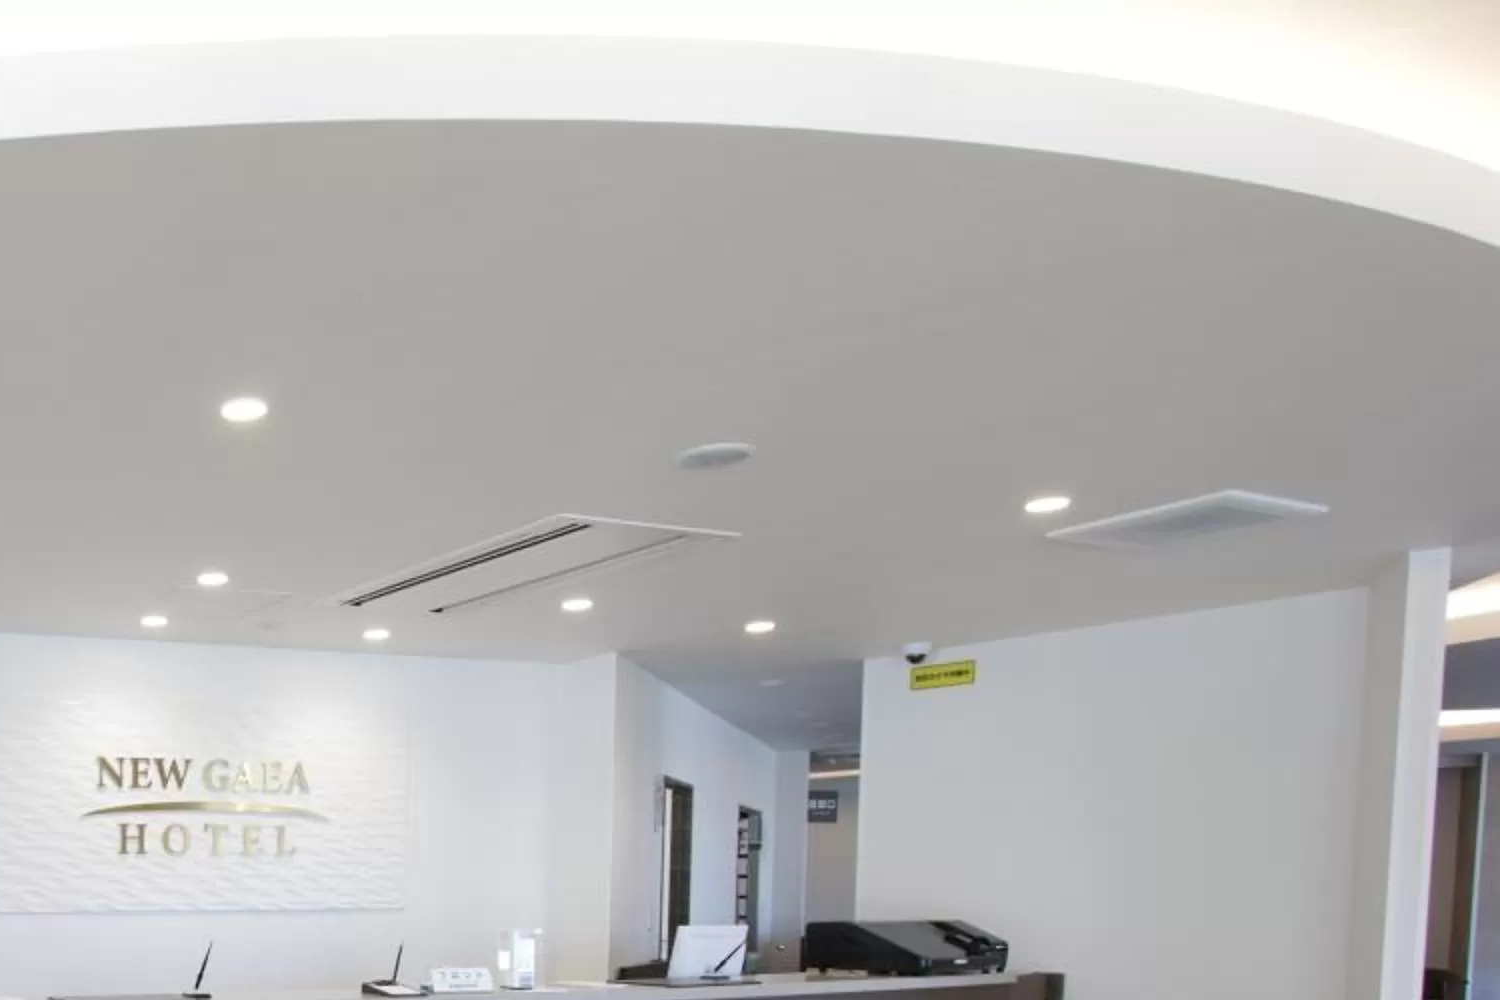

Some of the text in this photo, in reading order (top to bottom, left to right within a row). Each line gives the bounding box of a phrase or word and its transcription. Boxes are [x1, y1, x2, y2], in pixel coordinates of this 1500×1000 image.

[96, 756, 312, 795] NEW GAEA
[116, 822, 297, 859] HOTEL
